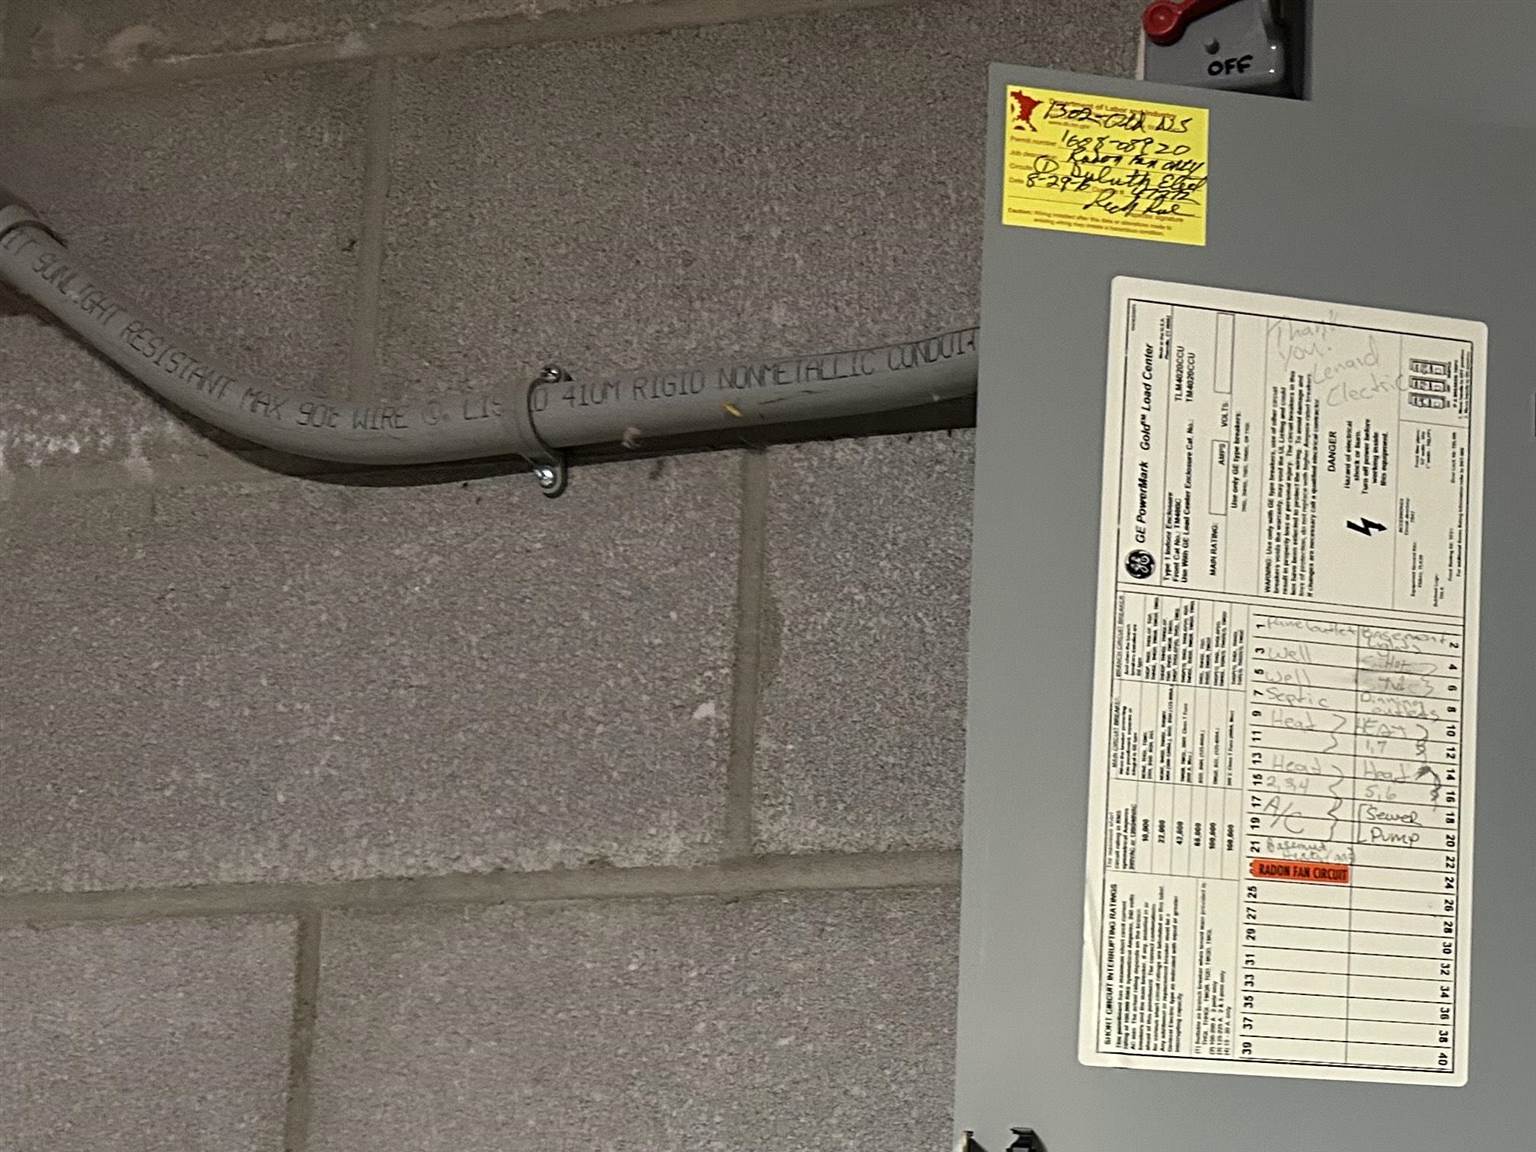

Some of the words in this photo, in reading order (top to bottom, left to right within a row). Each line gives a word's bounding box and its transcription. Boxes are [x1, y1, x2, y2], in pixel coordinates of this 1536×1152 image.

[1207, 55, 1253, 76] OFF
[1142, 343, 1153, 380] Center
[121, 320, 236, 400] RESISTANT
[240, 387, 286, 420] MAX
[352, 404, 409, 430] WIRE
[463, 389, 549, 421] LISD
[632, 369, 706, 401] RIGID
[718, 351, 876, 390] NONMETALLIC
[1174, 346, 1184, 402] TLM4020CCU
[1186, 352, 1196, 402] TM4020CCU
[1141, 383, 1152, 411] Load
[1218, 444, 1226, 466] AMPS
[1328, 431, 1337, 472] DANGER
[1184, 452, 1192, 489] Enclosure
[1232, 464, 1239, 474] GE
[1232, 477, 1240, 493] only
[1136, 461, 1149, 524] PowerMark
[1135, 526, 1146, 543] GE
[1164, 564, 1172, 580] Type
[1209, 556, 1217, 576] MAIN
[1265, 686, 1333, 708] Septic
[1252, 730, 1262, 741] 11
[1447, 725, 1456, 736] 10
[1252, 752, 1262, 764] 13
[1446, 747, 1456, 758] 12
[1253, 774, 1263, 786] 15
[1446, 769, 1455, 780] 14
[1252, 796, 1261, 807] 17
[1446, 791, 1456, 802] 16
[1263, 795, 1305, 835] A/C
[1446, 812, 1456, 823] 18
[1251, 818, 1261, 830] 19
[1369, 826, 1420, 849] Pump
[1446, 835, 1456, 847] 20
[1250, 840, 1260, 853] 21
[1445, 856, 1455, 869] 22
[1258, 862, 1291, 878] RADON
[1293, 864, 1312, 879] FAN
[1312, 867, 1349, 882] CIRCUIT
[1445, 877, 1454, 889] 24
[1247, 886, 1257, 898] 25
[1108, 884, 1118, 920] RATINGS
[1444, 899, 1454, 912] 26
[1246, 907, 1256, 920] 27
[1443, 921, 1453, 933] 28
[1246, 928, 1256, 941] 29
[1106, 921, 1117, 981] INTERRUPTING
[1442, 942, 1452, 954] 30
[1245, 954, 1255, 965] 31
[1441, 963, 1450, 976] 32
[1244, 974, 1254, 987] 33
[1440, 986, 1450, 998] 34
[1105, 983, 1114, 1015] CIRCUIT
[1243, 996, 1254, 1008] 35
[1440, 1008, 1450, 1020] 36
[1242, 1017, 1253, 1030] 37
[1104, 1017, 1113, 1045] SHORT
[1439, 1030, 1448, 1043] 38
[1242, 1042, 1252, 1055] 39
[1438, 1053, 1448, 1066] 40
